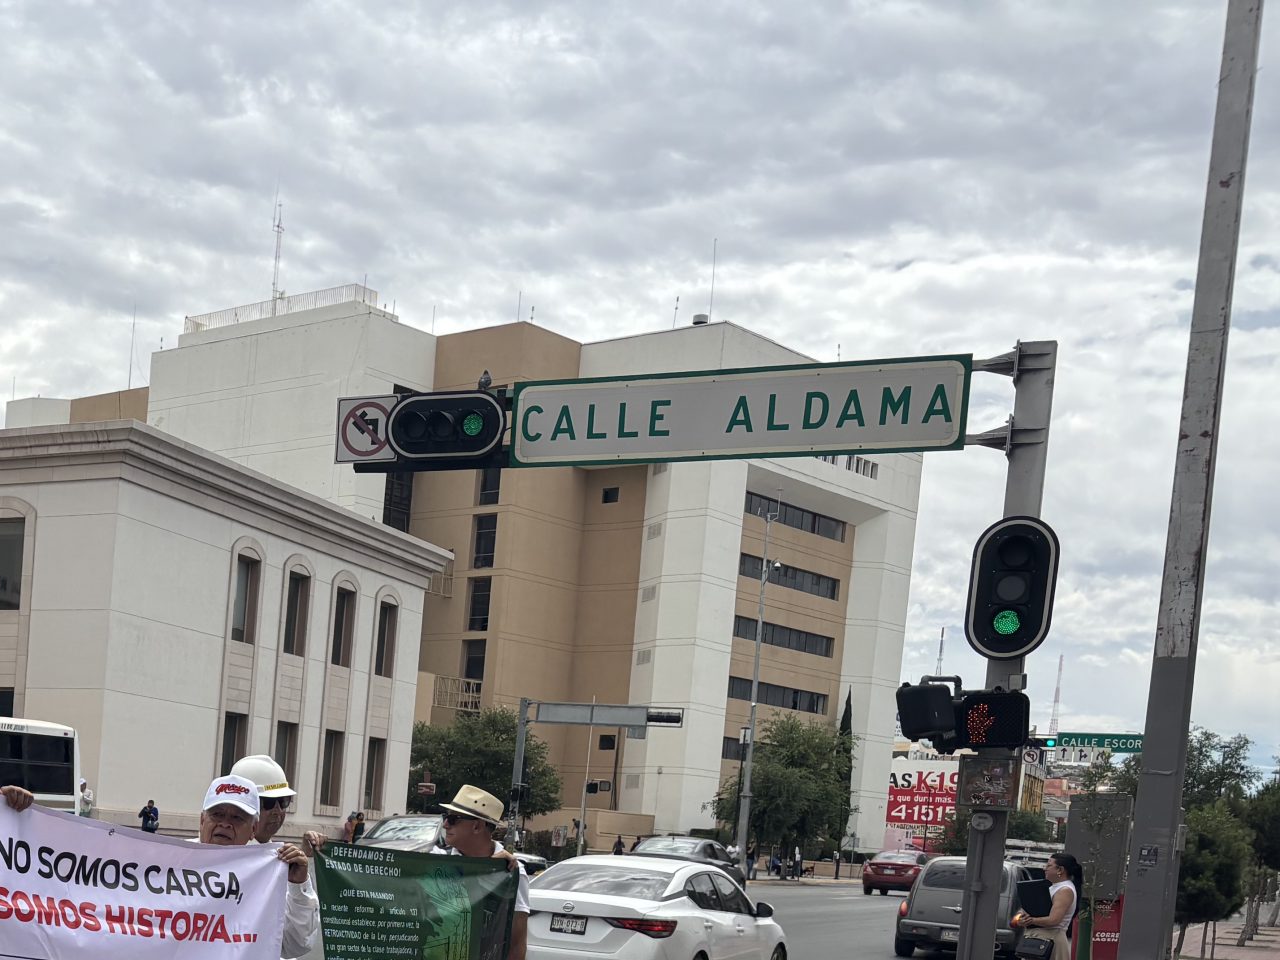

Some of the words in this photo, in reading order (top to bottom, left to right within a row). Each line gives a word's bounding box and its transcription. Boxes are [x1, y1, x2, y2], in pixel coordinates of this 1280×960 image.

[521, 400, 672, 442] CALLE
[725, 383, 953, 433] ALDAMA
[1061, 737, 1098, 748] CALLE
[913, 770, 960, 794] K-19
[896, 795, 912, 803] que
[386, 852, 395, 862] EL
[325, 859, 352, 872] ESTADO
[353, 863, 363, 873] DE
[365, 865, 401, 877] DERECHO!
[37, 846, 140, 892] SOMOS
[143, 865, 243, 905] CARGA,
[354, 905, 374, 914] reforma
[105, 904, 258, 944] HISTORIA...
[377, 920, 386, 929] por
[387, 920, 405, 929] primera
[324, 928, 362, 940] RETROACTIVIDAD
[362, 931, 370, 940] de
[370, 932, 376, 940] la
[336, 944, 347, 953] gran
[360, 945, 366, 953] de
[372, 945, 385, 954] clase
